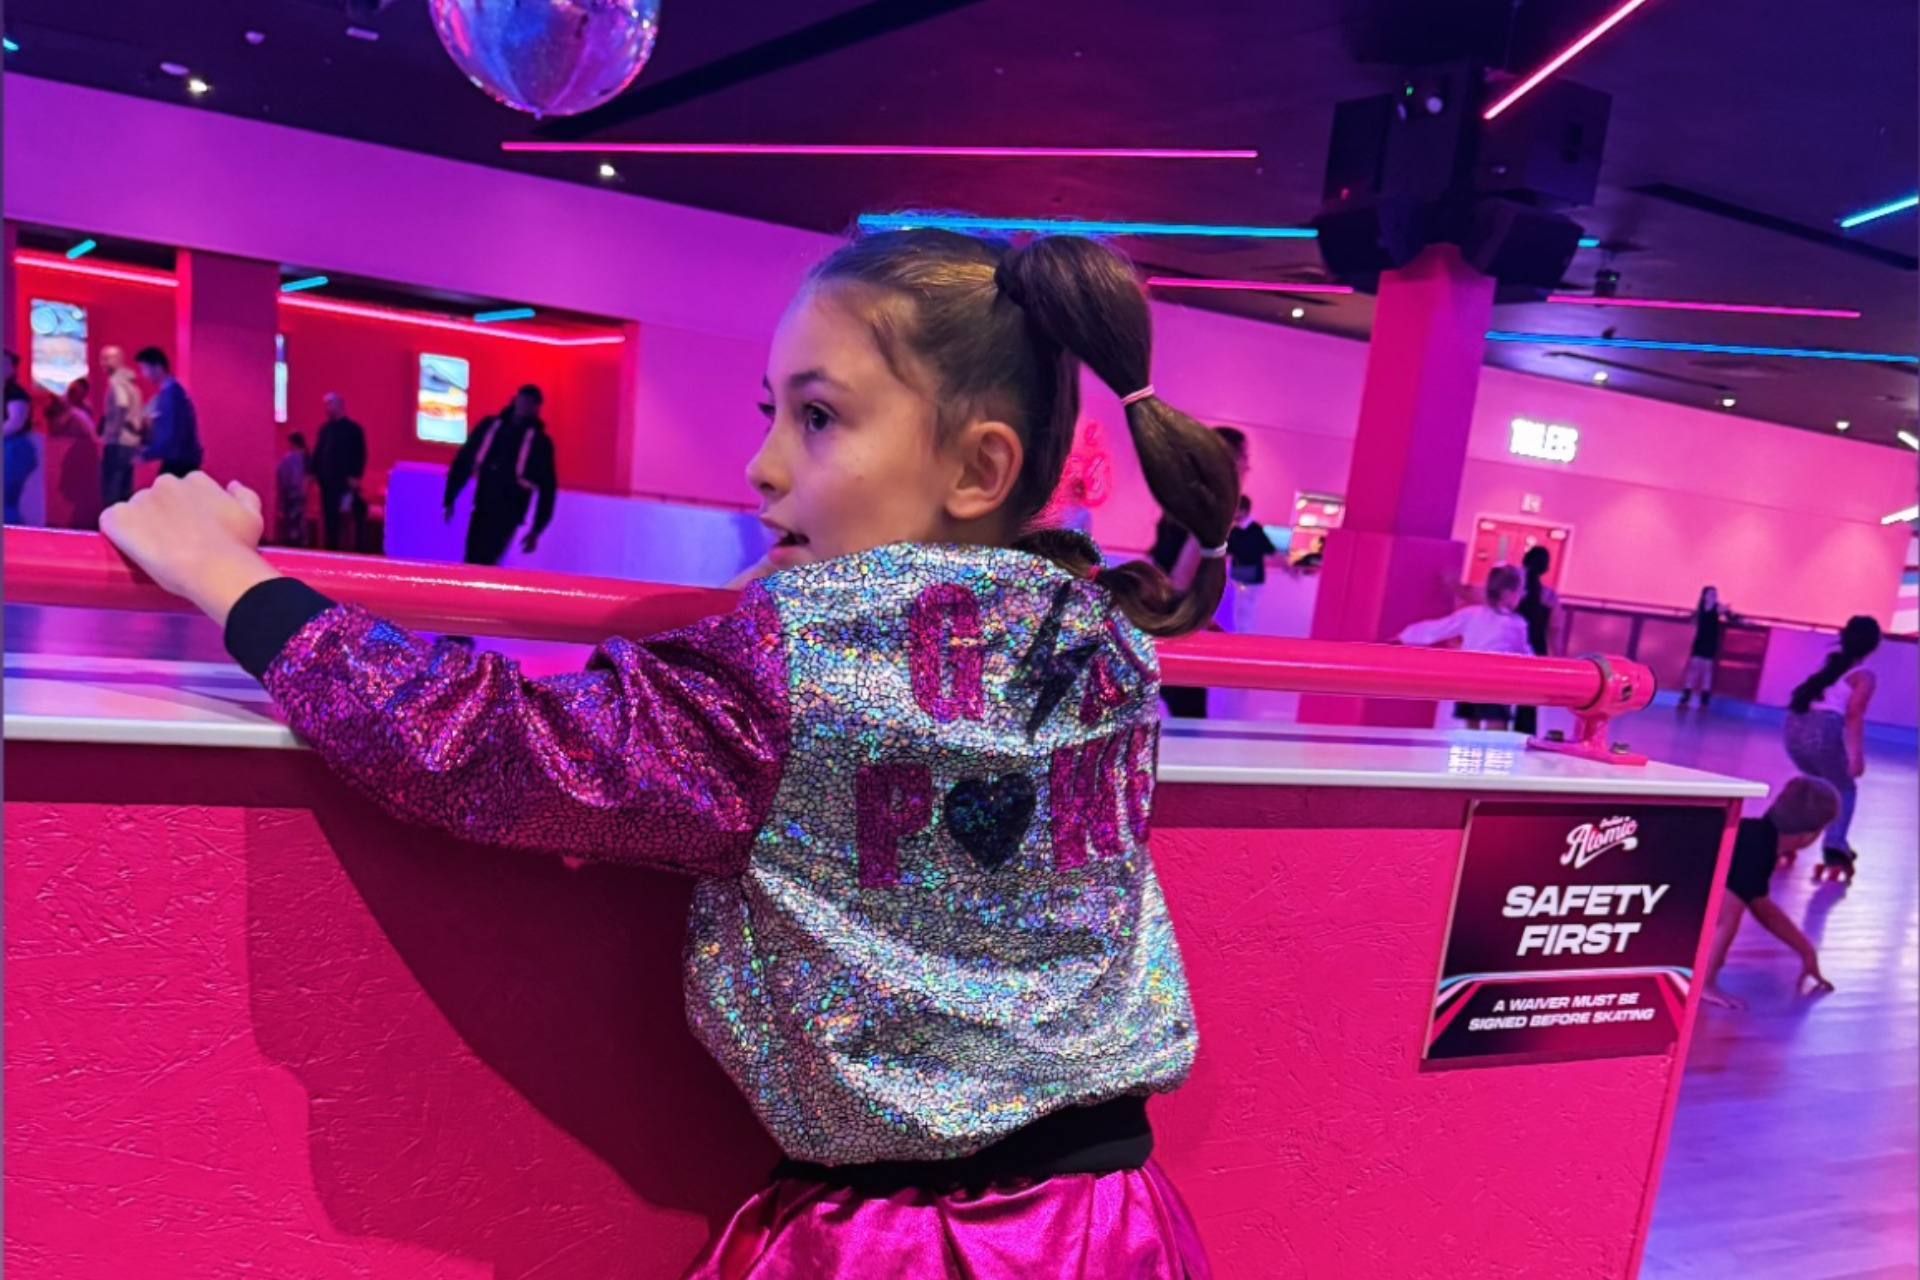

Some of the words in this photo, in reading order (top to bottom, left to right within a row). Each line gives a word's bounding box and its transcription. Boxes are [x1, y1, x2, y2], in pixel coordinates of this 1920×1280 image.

[1560, 816, 1638, 869] Atomic
[1502, 884, 1669, 917] SAFETY
[1516, 922, 1640, 955] FIRST
[1493, 1000, 1505, 1012] A
[1509, 997, 1570, 1011] WAIVER
[1572, 994, 1616, 1007] MUST
[1618, 992, 1639, 1004] BE
[1468, 1016, 1527, 1030] SIGNED
[1530, 1012, 1591, 1027] BEFORE
[1592, 1008, 1655, 1022] SKATING
